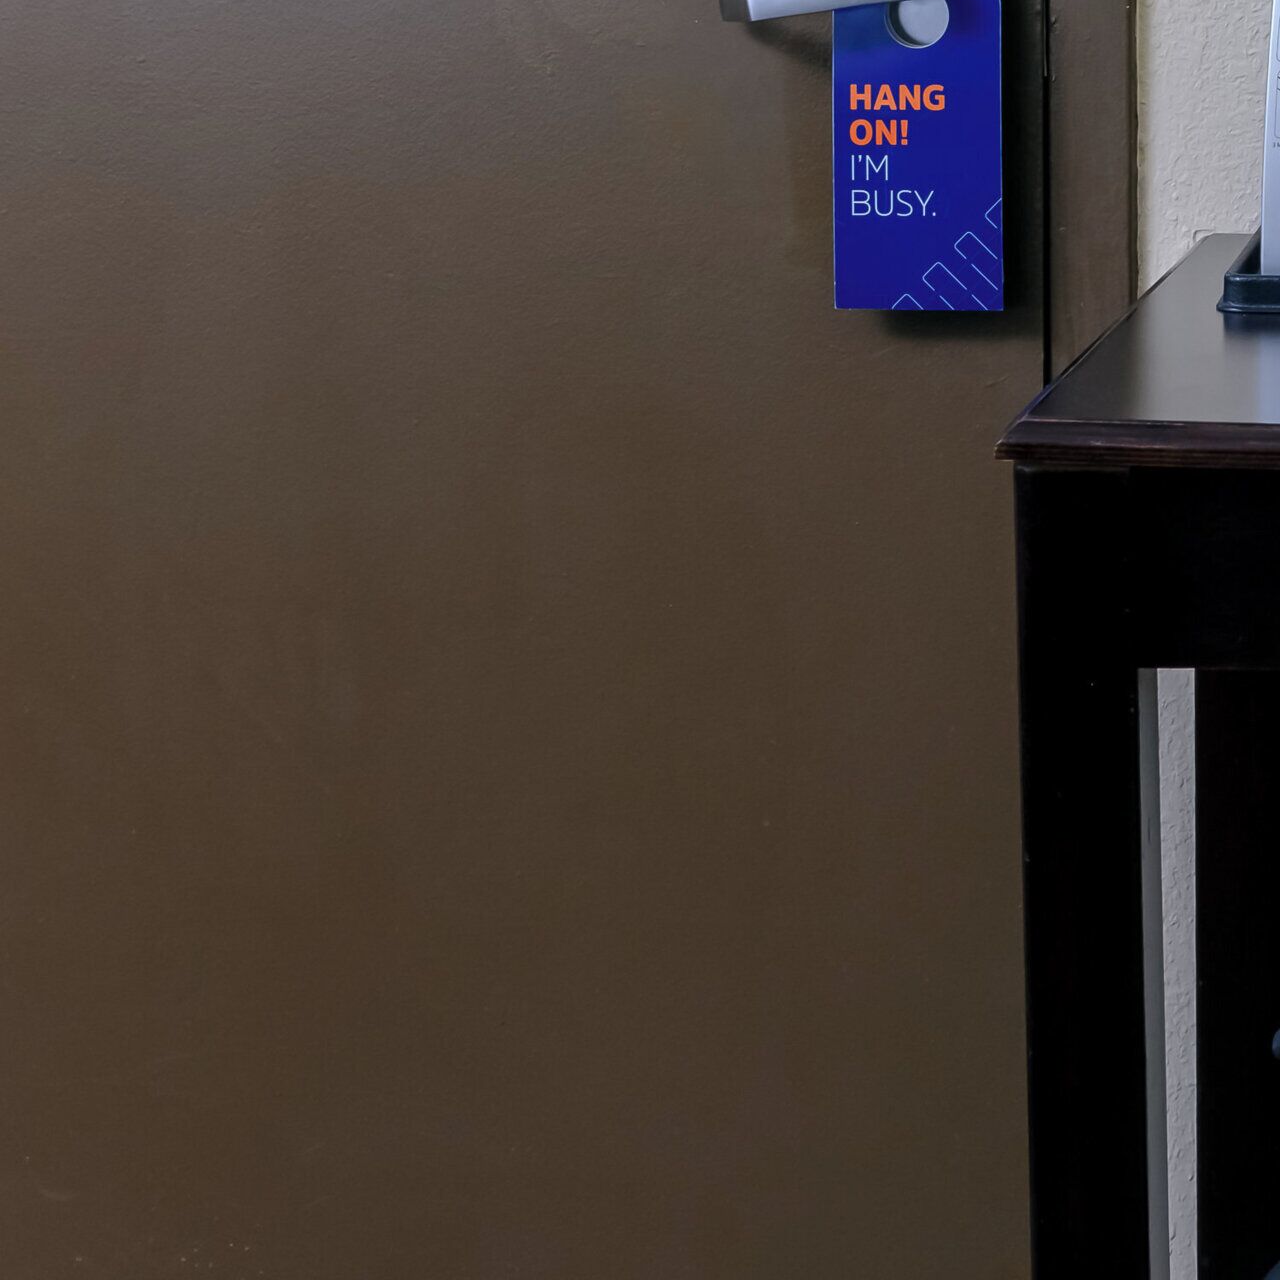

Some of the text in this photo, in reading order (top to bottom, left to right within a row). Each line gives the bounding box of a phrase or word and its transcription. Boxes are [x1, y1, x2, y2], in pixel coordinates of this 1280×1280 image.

[850, 84, 946, 110] HANG
[849, 119, 909, 146] ON!
[851, 154, 889, 181] I'M
[852, 189, 936, 216] BUSY.
